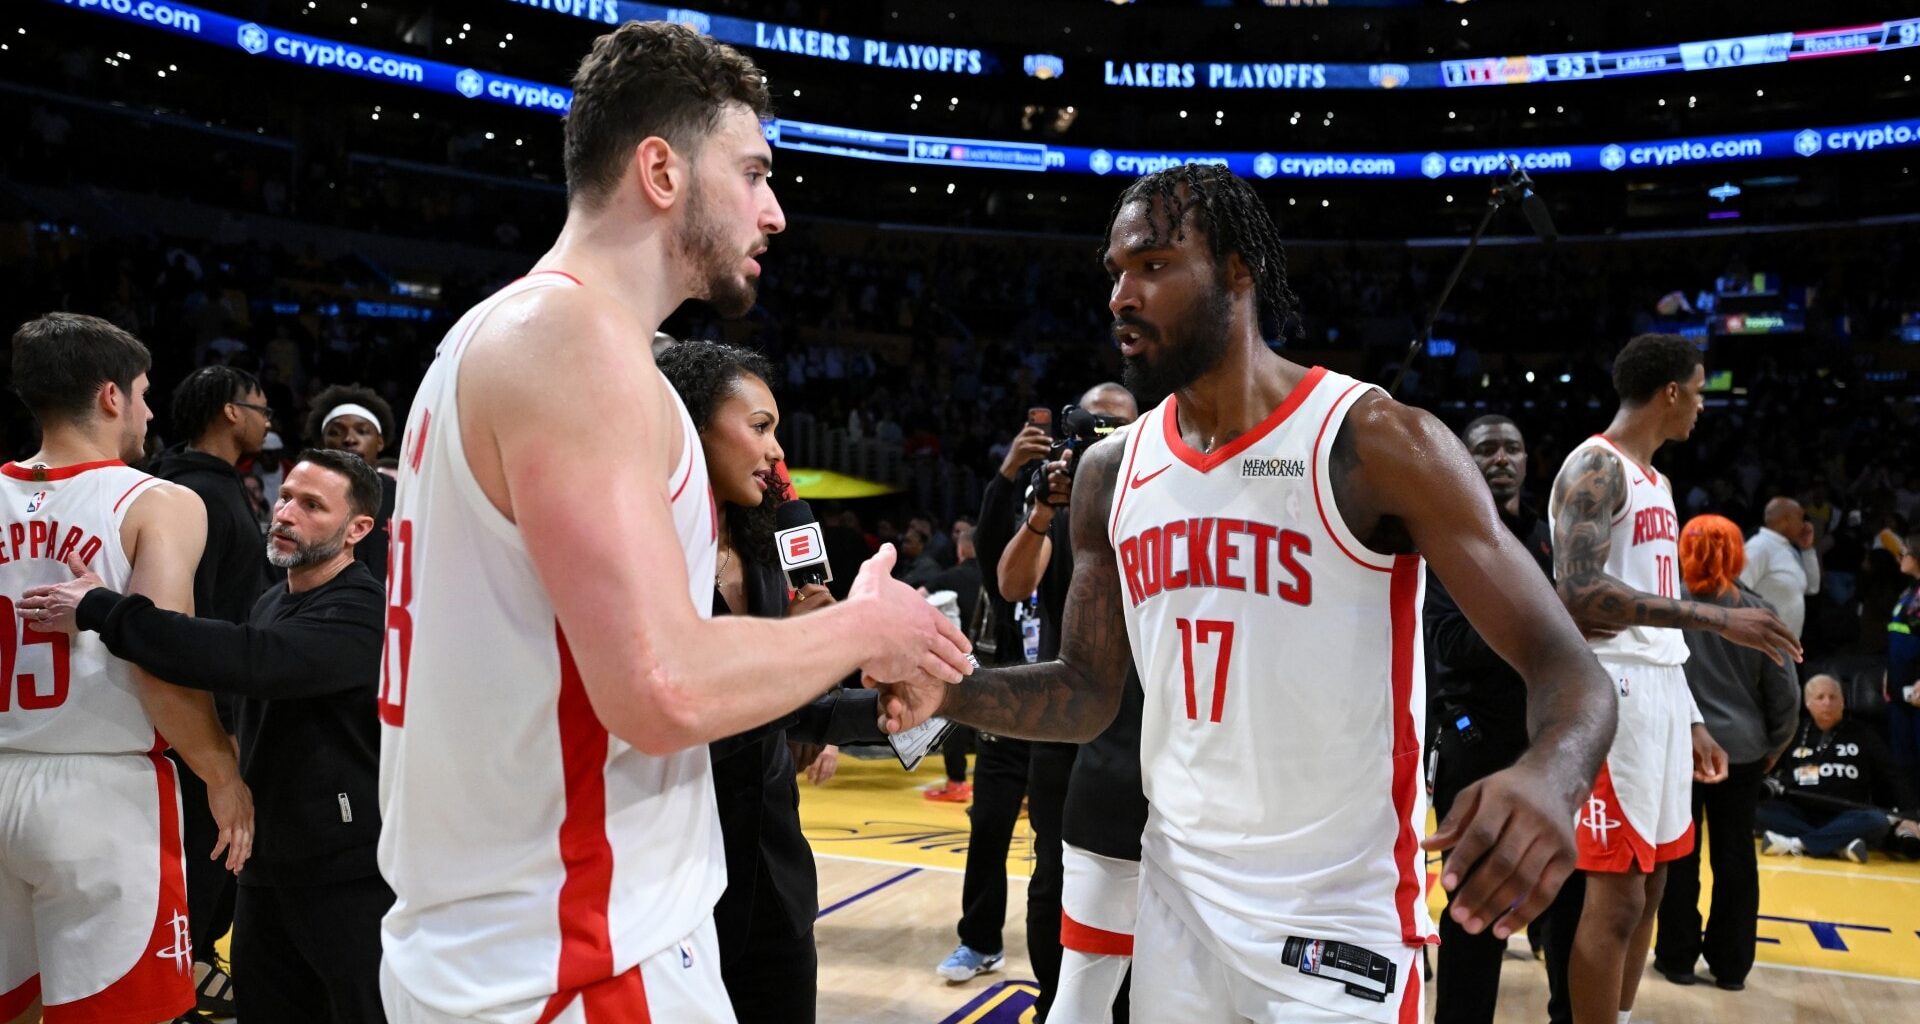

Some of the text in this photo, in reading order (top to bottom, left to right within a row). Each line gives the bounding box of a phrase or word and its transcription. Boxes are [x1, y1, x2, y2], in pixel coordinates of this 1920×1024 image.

[274, 36, 423, 82] crypto.com
[756, 22, 850, 60] LAKERS
[864, 39, 981, 75] PLAYOFFS
[1556, 56, 1587, 78] 93
[1899, 22, 1920, 46] 9
[1105, 61, 1326, 89] LAKERS PLAYOFFS
[1827, 123, 1920, 150] crypto.
[1449, 151, 1571, 175] crypto.com
[1630, 138, 1762, 165] crypto.com
[1280, 155, 1396, 177] crypto.com
[1242, 467, 1305, 477] HERMANN
[1243, 458, 1305, 469] MEMORIAL
[1119, 517, 1312, 608] ROCKETS
[1656, 554, 1675, 599] 10
[1176, 617, 1235, 723] 17
[1835, 743, 1859, 757] 20
